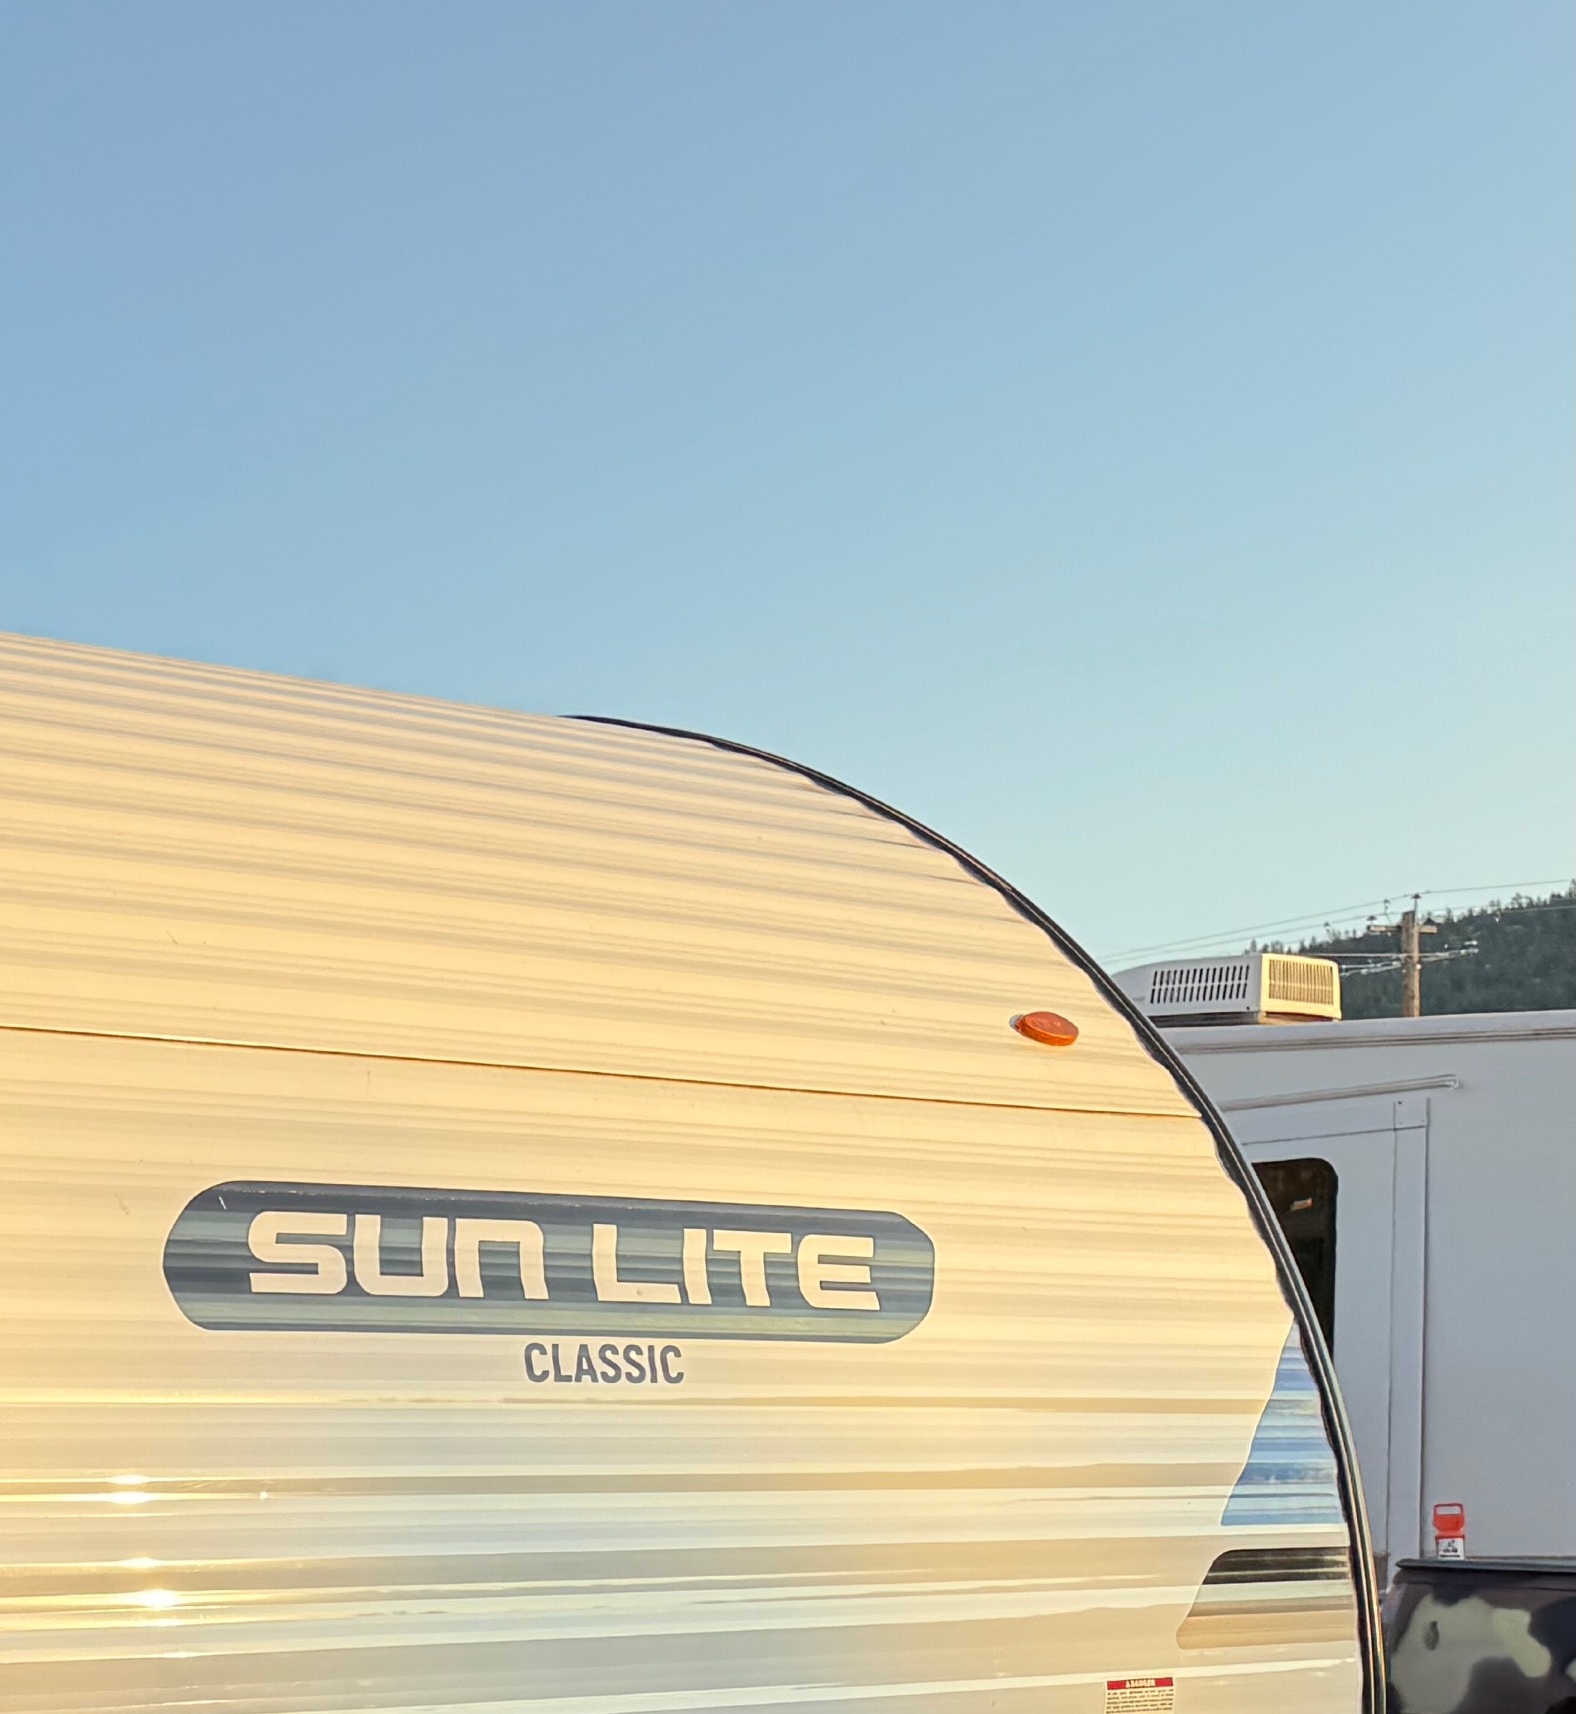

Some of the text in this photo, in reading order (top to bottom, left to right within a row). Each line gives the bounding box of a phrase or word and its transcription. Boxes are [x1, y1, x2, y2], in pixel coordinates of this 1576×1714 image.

[247, 1210, 881, 1311] SUN LITE
[524, 1342, 685, 1385] CLASSIC
